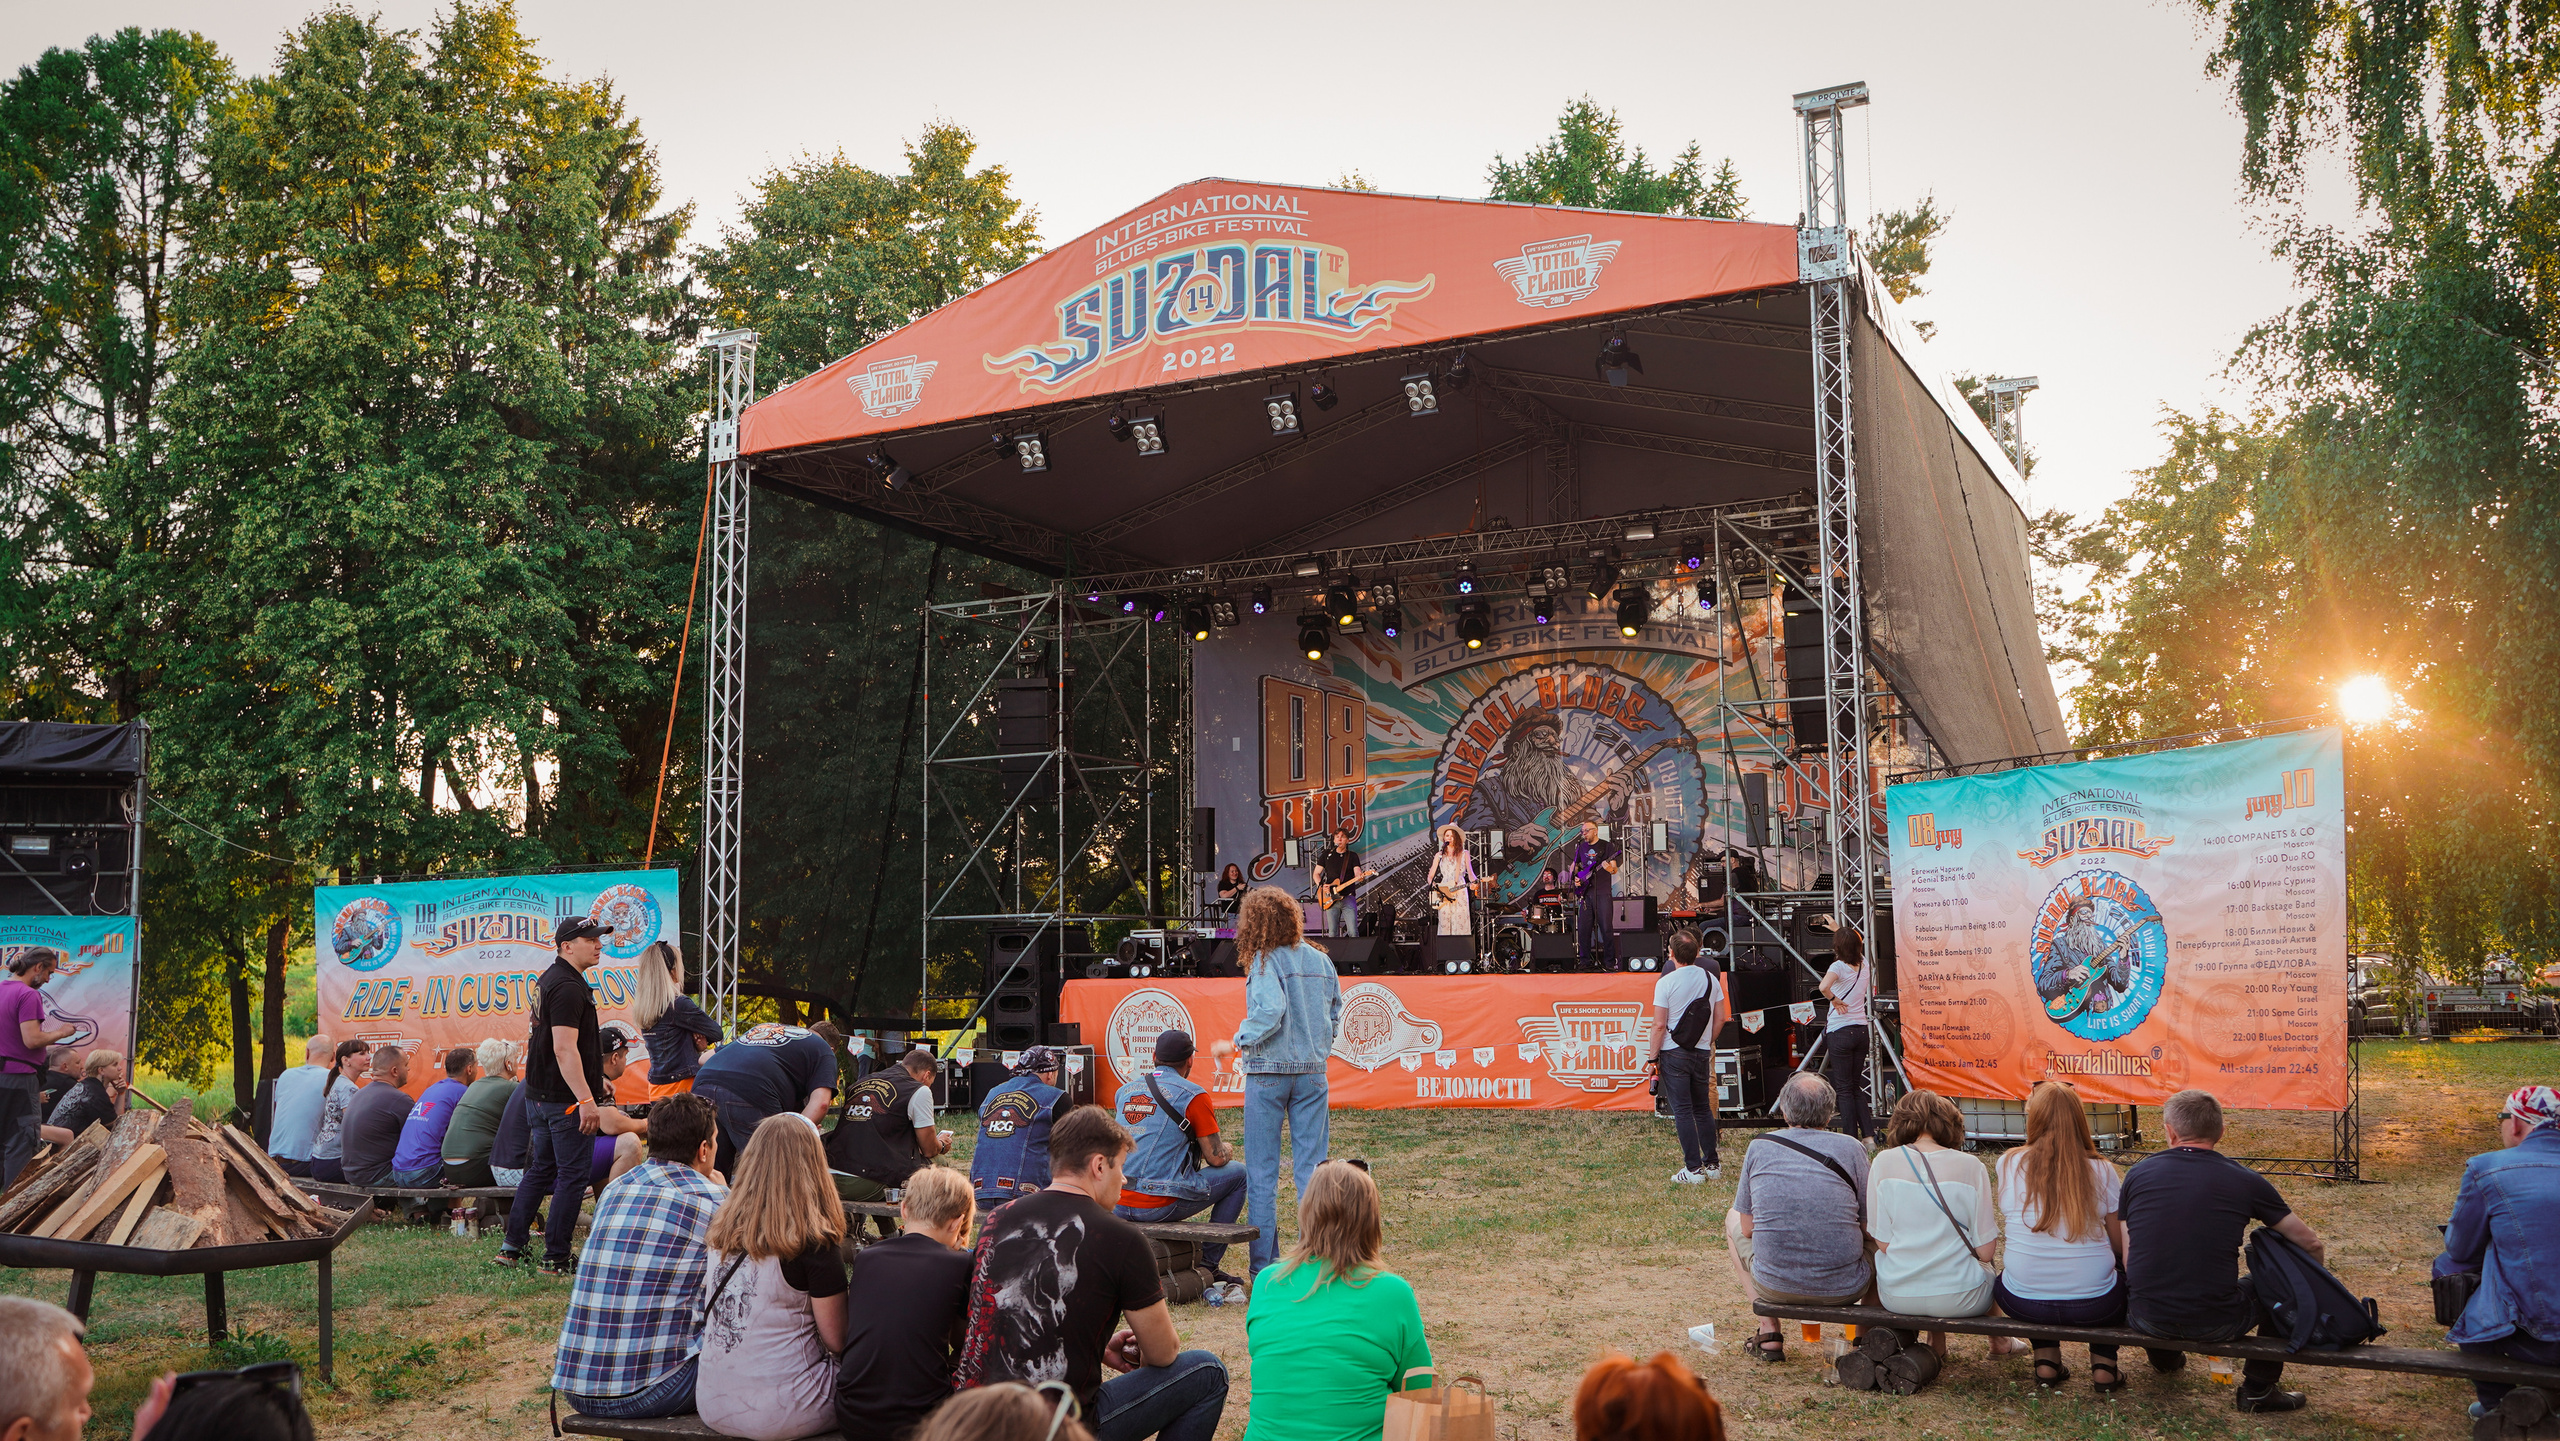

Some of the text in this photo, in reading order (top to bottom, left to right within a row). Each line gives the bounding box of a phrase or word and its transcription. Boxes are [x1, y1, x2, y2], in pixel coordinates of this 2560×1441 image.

[1095, 194, 1309, 256] INTERNATIONAL
[1095, 219, 1309, 276] BLUES-BIKE FESTIVAL
[1533, 250, 1580, 273] TOTAL
[1184, 285, 1215, 314] 14
[1034, 244, 1361, 375] SUZDAL
[1162, 343, 1236, 373] 2022
[874, 369, 909, 388] TOTAL
[1583, 625, 1718, 652] FETIVAL
[1258, 674, 1367, 799] 08
[1443, 674, 1655, 808] SUZDAL BLUES
[2281, 768, 2315, 809] 10
[2042, 788, 2143, 814] INTERNATIONAL
[2043, 803, 2145, 827] BLUES-BIKE FESTIVAL
[1907, 813, 1936, 847] 08
[2203, 827, 2315, 845] 14:00 COMPANETS & CO
[2036, 817, 2155, 862] SUZDAL
[2088, 832, 2098, 843] 14
[2283, 840, 2315, 848] Moscow
[2080, 857, 2106, 865] 2022
[2255, 851, 2315, 864] 15:00 Duo RO
[1911, 866, 1964, 876] Евгений Чаркин
[2285, 864, 2316, 872] Moscow
[1917, 875, 1939, 884] Genial
[1940, 874, 1956, 882] Band
[1958, 872, 1976, 881] 16:00
[2227, 877, 2316, 890] 16:00 Ирина Сурина
[2080, 876, 2143, 912] BLUES
[2285, 888, 2316, 896] Moscow
[442, 888, 549, 910] INTERNATIONAL
[1913, 898, 1969, 909] Комната 60 17:00
[442, 901, 549, 921] BLUES-BIKE FESTIVAL
[555, 896, 573, 917] 10
[2226, 900, 2316, 913] 17:00 Backstage Band
[415, 903, 437, 924] 08
[2286, 912, 2316, 920] Moscow
[1, 925, 70, 940] RNATIONAL
[432, 913, 556, 952] SUZDAL
[1915, 924, 1943, 933] Fabulous
[1968, 922, 1987, 932] Being
[1987, 921, 2007, 929] 18:00
[2225, 923, 2316, 937] 18:00 Билли Новик &
[103, 933, 125, 953] 10
[2143, 928, 2157, 958] HARD
[2176, 936, 2317, 950] Петербургский Джазовый Актив
[479, 950, 512, 960] 2022
[1916, 947, 1992, 957] The Beat Bombers 19:00
[2254, 947, 2317, 956] Saint-Petersburg
[2148, 962, 2156, 974] IT
[2195, 959, 2317, 972] 19:00 Группа «ФЕДУЛОВА»
[1952, 973, 1977, 981] Friends
[1977, 972, 1997, 980] 20:00
[2285, 971, 2317, 979] Moscow
[2141, 974, 2155, 992] DO
[2245, 984, 2318, 994] 20:00 Roy Young
[343, 968, 640, 1018] RIDE IN CUSTO HOW
[1376, 987, 1400, 1010] BIKERS
[2297, 995, 2318, 1003] Israel
[1919, 997, 1987, 1007] Степные Битлы 21:00
[2247, 1008, 2318, 1017] 21:00 Some Girls
[1921, 1023, 1970, 1032] Леван Ломидзе
[2087, 1017, 2108, 1030] LIFE
[2109, 1015, 2120, 1028] IS
[1132, 1035, 1159, 1043] BROTH
[1946, 1032, 1972, 1040] Cousins
[1972, 1032, 1991, 1041] 22:00
[2232, 1032, 2319, 1041] 22:00 Blues Doctors
[2267, 1045, 2318, 1054] Yekaterinburg
[1924, 1058, 1998, 1068] All-stars Jam 22:45
[2045, 1048, 2152, 1079] #suzdalblues
[2219, 1063, 2319, 1074] All-stars Jam 22:45
[1416, 1076, 1532, 1100] ВЕДОМОСТИ
[1590, 1077, 1609, 1088] 2010
[847, 1104, 873, 1117] HOG
[988, 1120, 1014, 1132] HOG
